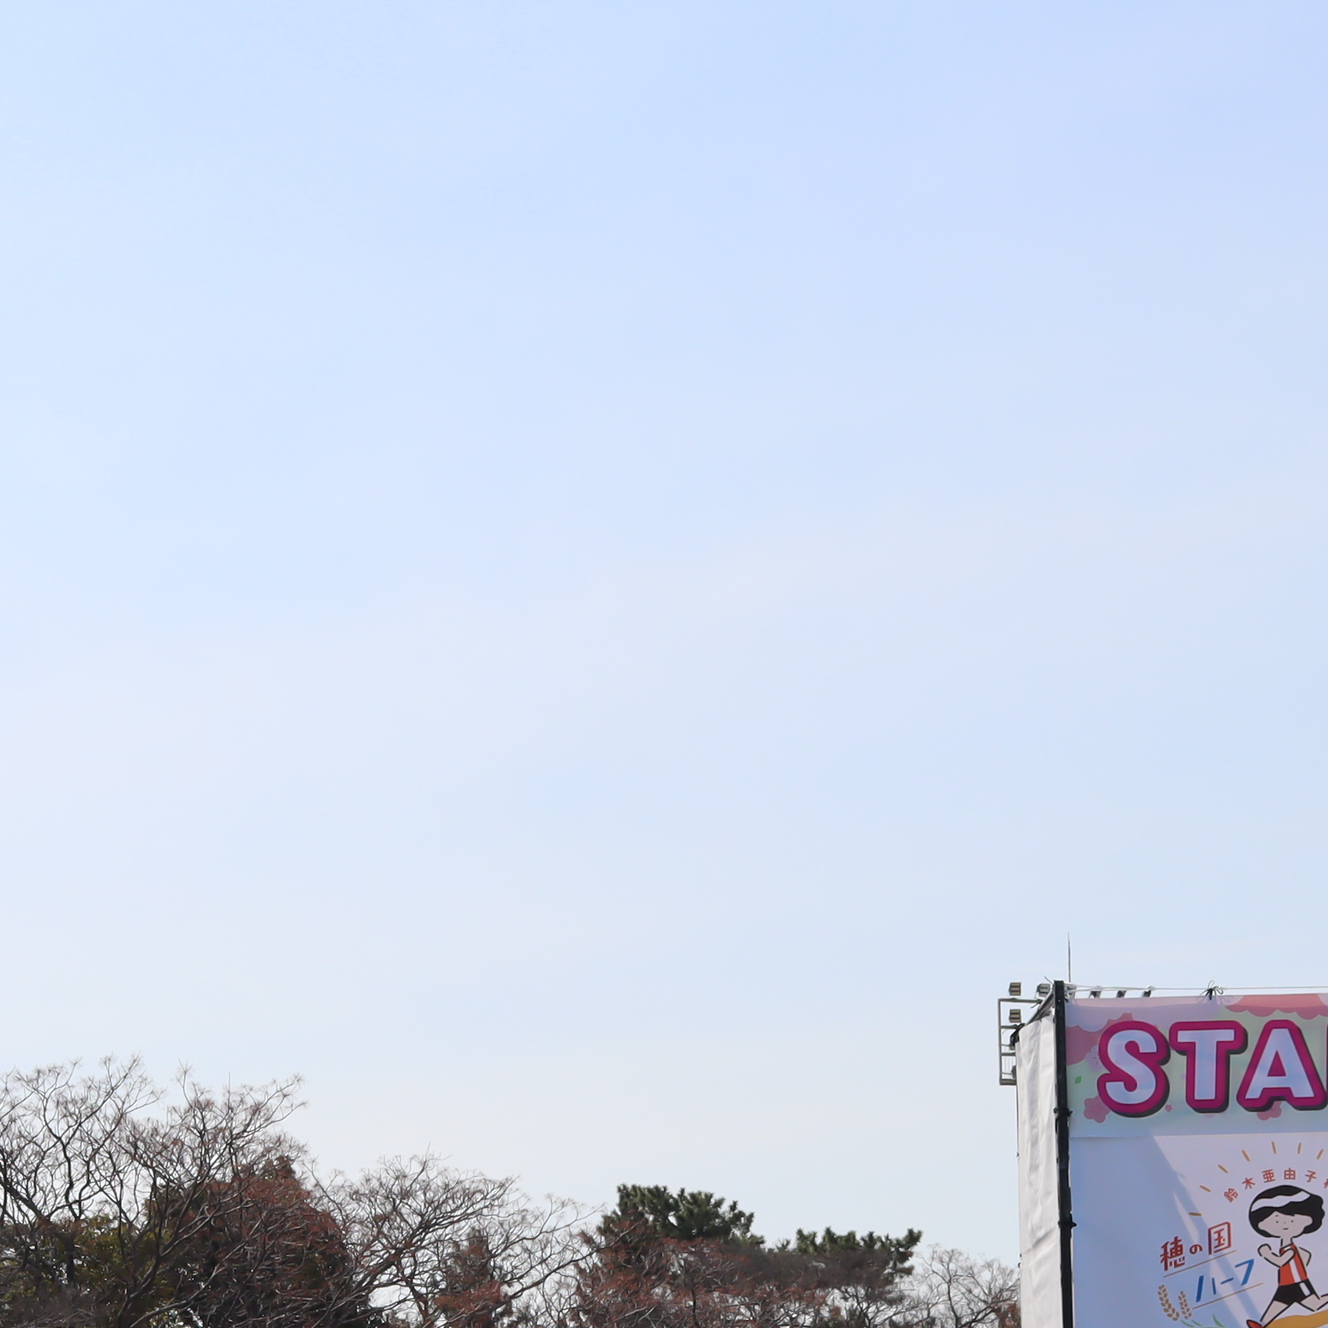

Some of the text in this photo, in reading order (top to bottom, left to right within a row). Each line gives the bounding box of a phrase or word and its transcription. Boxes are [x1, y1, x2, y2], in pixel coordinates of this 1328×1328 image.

[1160, 1221, 1233, 1272] 穂の国
[1195, 1258, 1256, 1303] ハーフ
